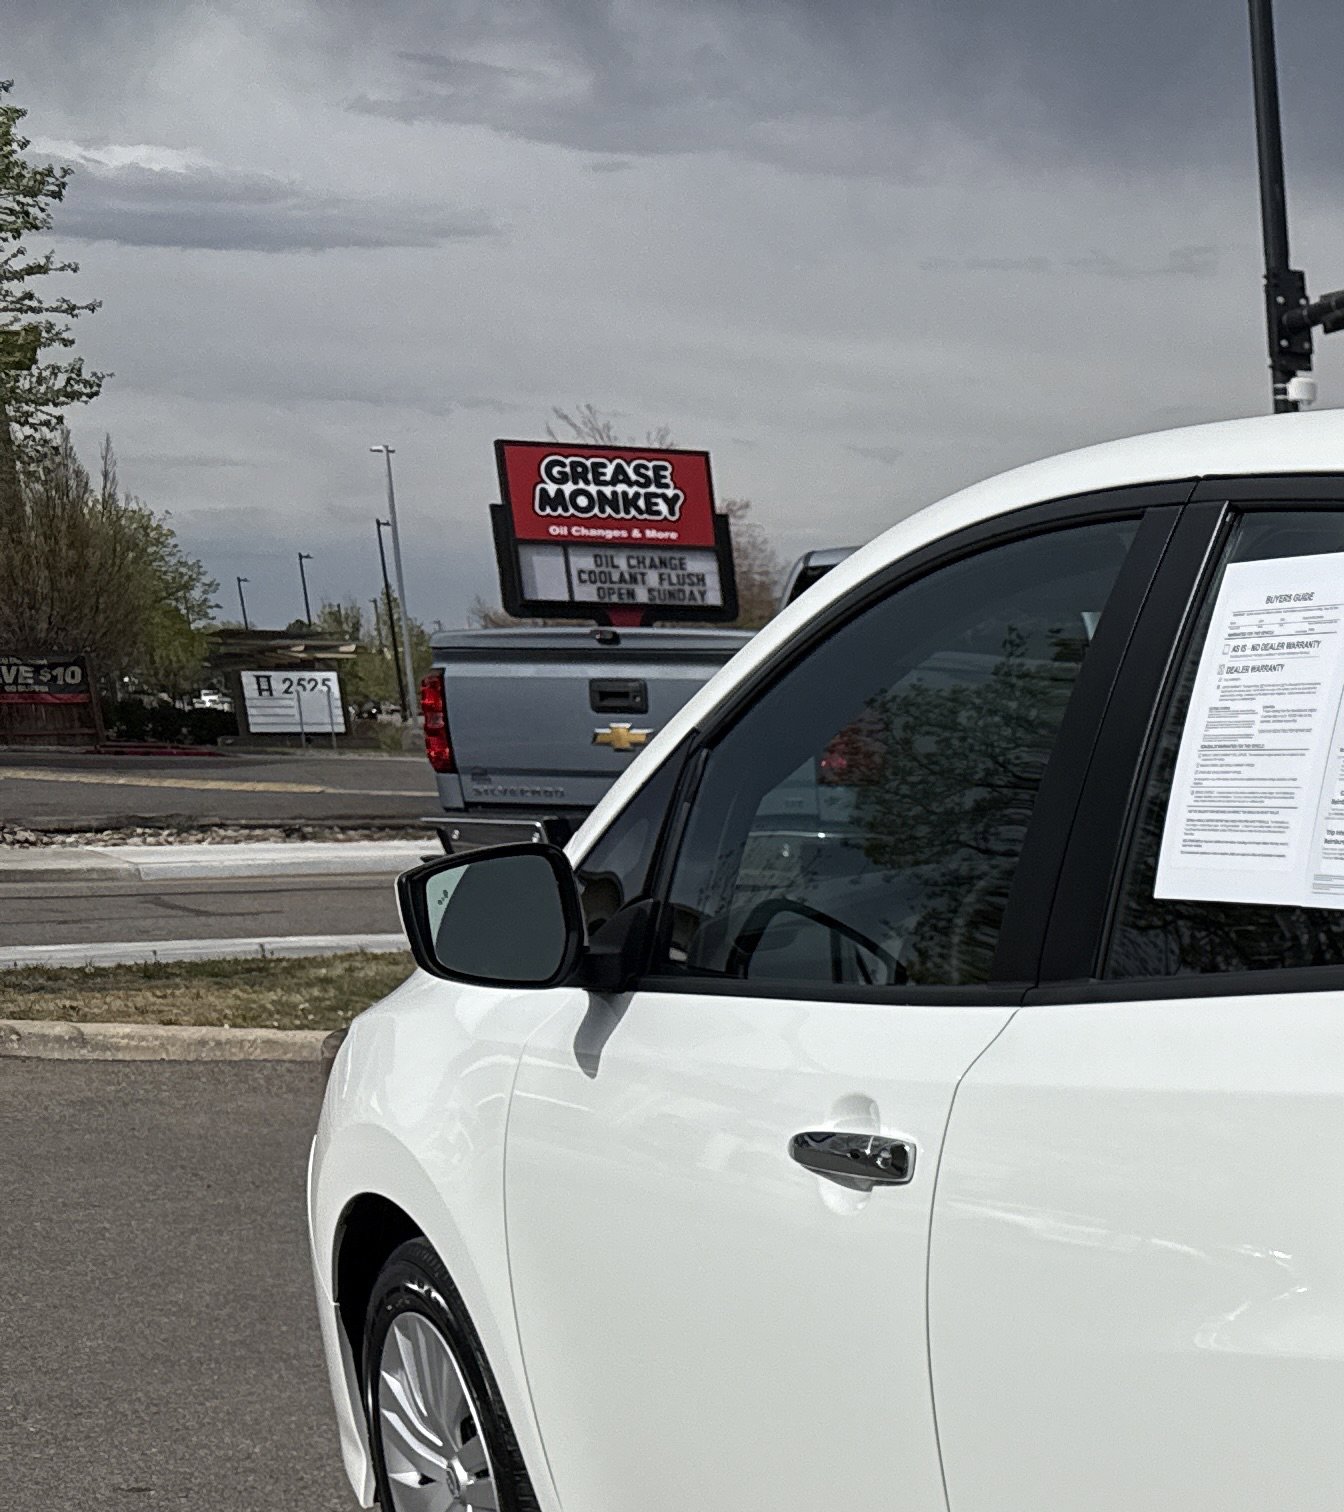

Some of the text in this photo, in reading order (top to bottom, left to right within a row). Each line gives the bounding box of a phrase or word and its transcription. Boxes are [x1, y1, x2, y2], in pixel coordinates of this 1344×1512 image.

[542, 457, 673, 491] GREASE
[536, 485, 682, 519] MONKEY
[548, 526, 679, 539] Oil Changes & More
[593, 554, 687, 571] OIL CHANGE
[577, 570, 707, 587] COOLANT FLUSH
[596, 586, 708, 603] OPEN SUNDAY
[1293, 592, 1315, 602] GUIDE
[1286, 640, 1321, 650] WARRANTY
[0, 665, 82, 685] VE $10
[1250, 664, 1285, 673] WARRANTY
